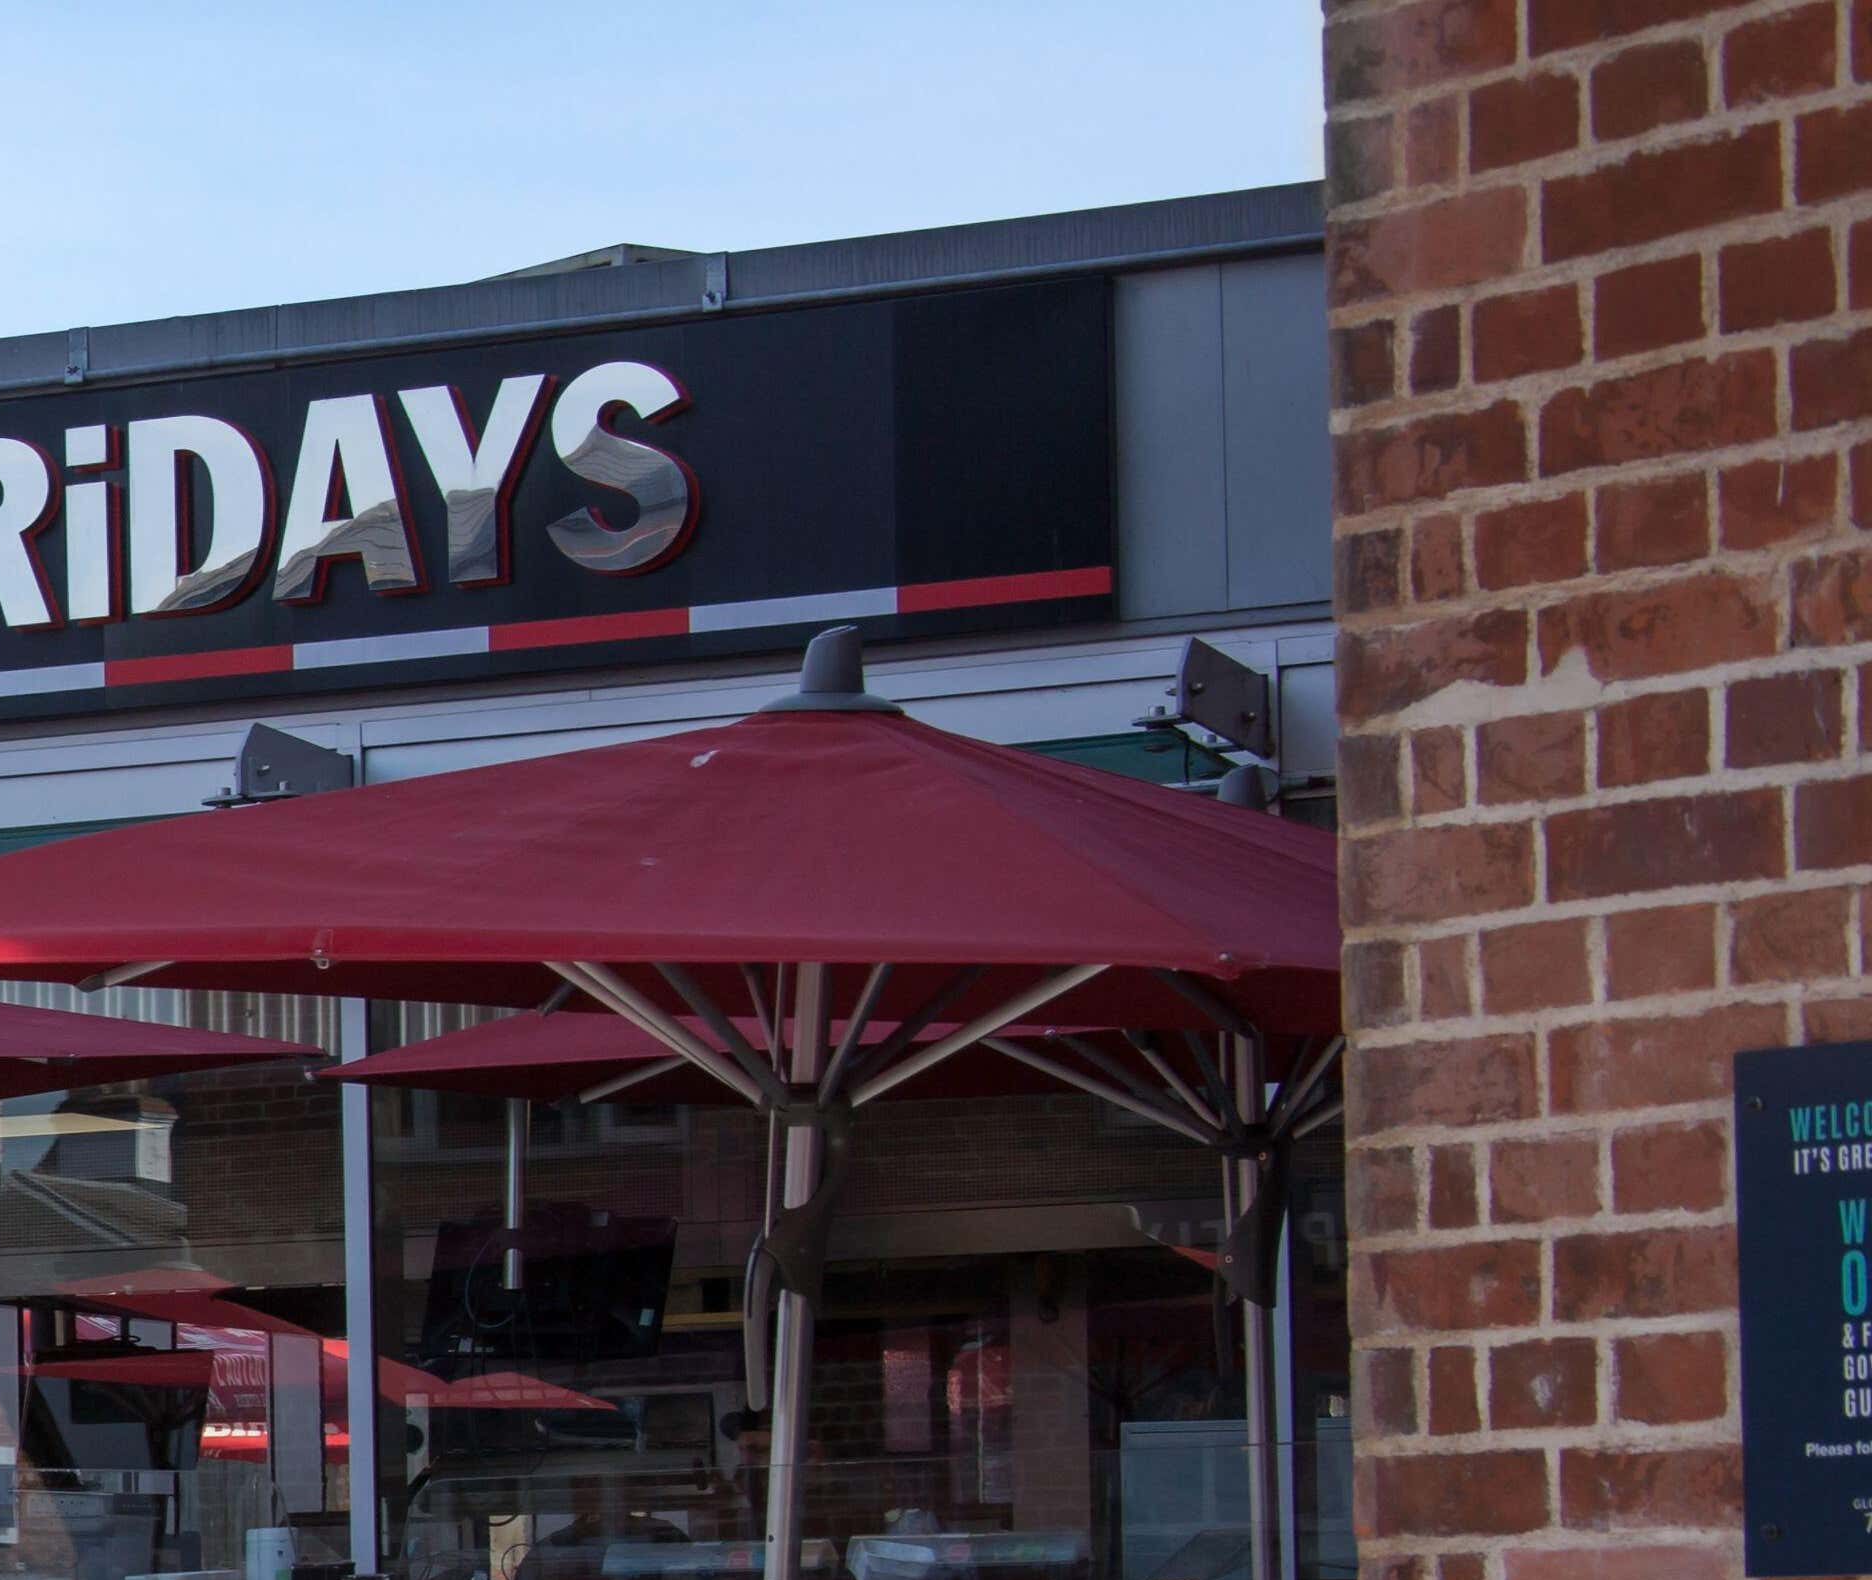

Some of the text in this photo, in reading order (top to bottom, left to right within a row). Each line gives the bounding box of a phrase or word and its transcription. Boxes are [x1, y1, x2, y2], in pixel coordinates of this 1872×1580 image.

[1793, 1147, 1831, 1175] IT'S
[1844, 1352, 1872, 1381] GO
[1806, 1441, 1853, 1457] Please
